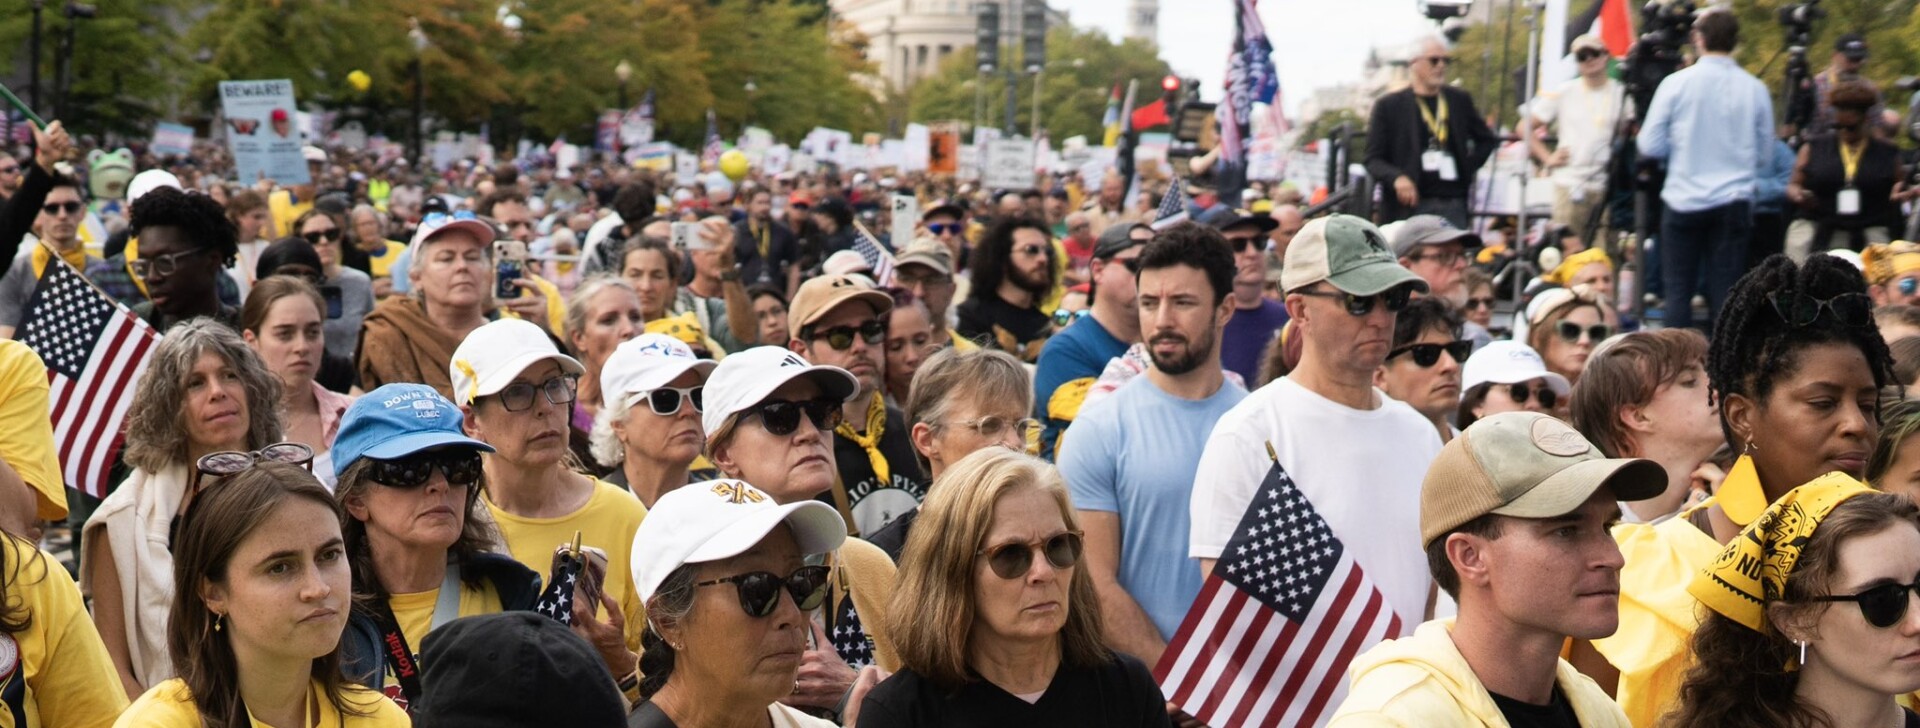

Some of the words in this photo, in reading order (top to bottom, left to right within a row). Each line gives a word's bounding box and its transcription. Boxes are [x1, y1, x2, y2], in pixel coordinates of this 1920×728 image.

[383, 390, 421, 408] DOWN
[1735, 552, 1762, 582] NO
[385, 631, 415, 678] Kodak
